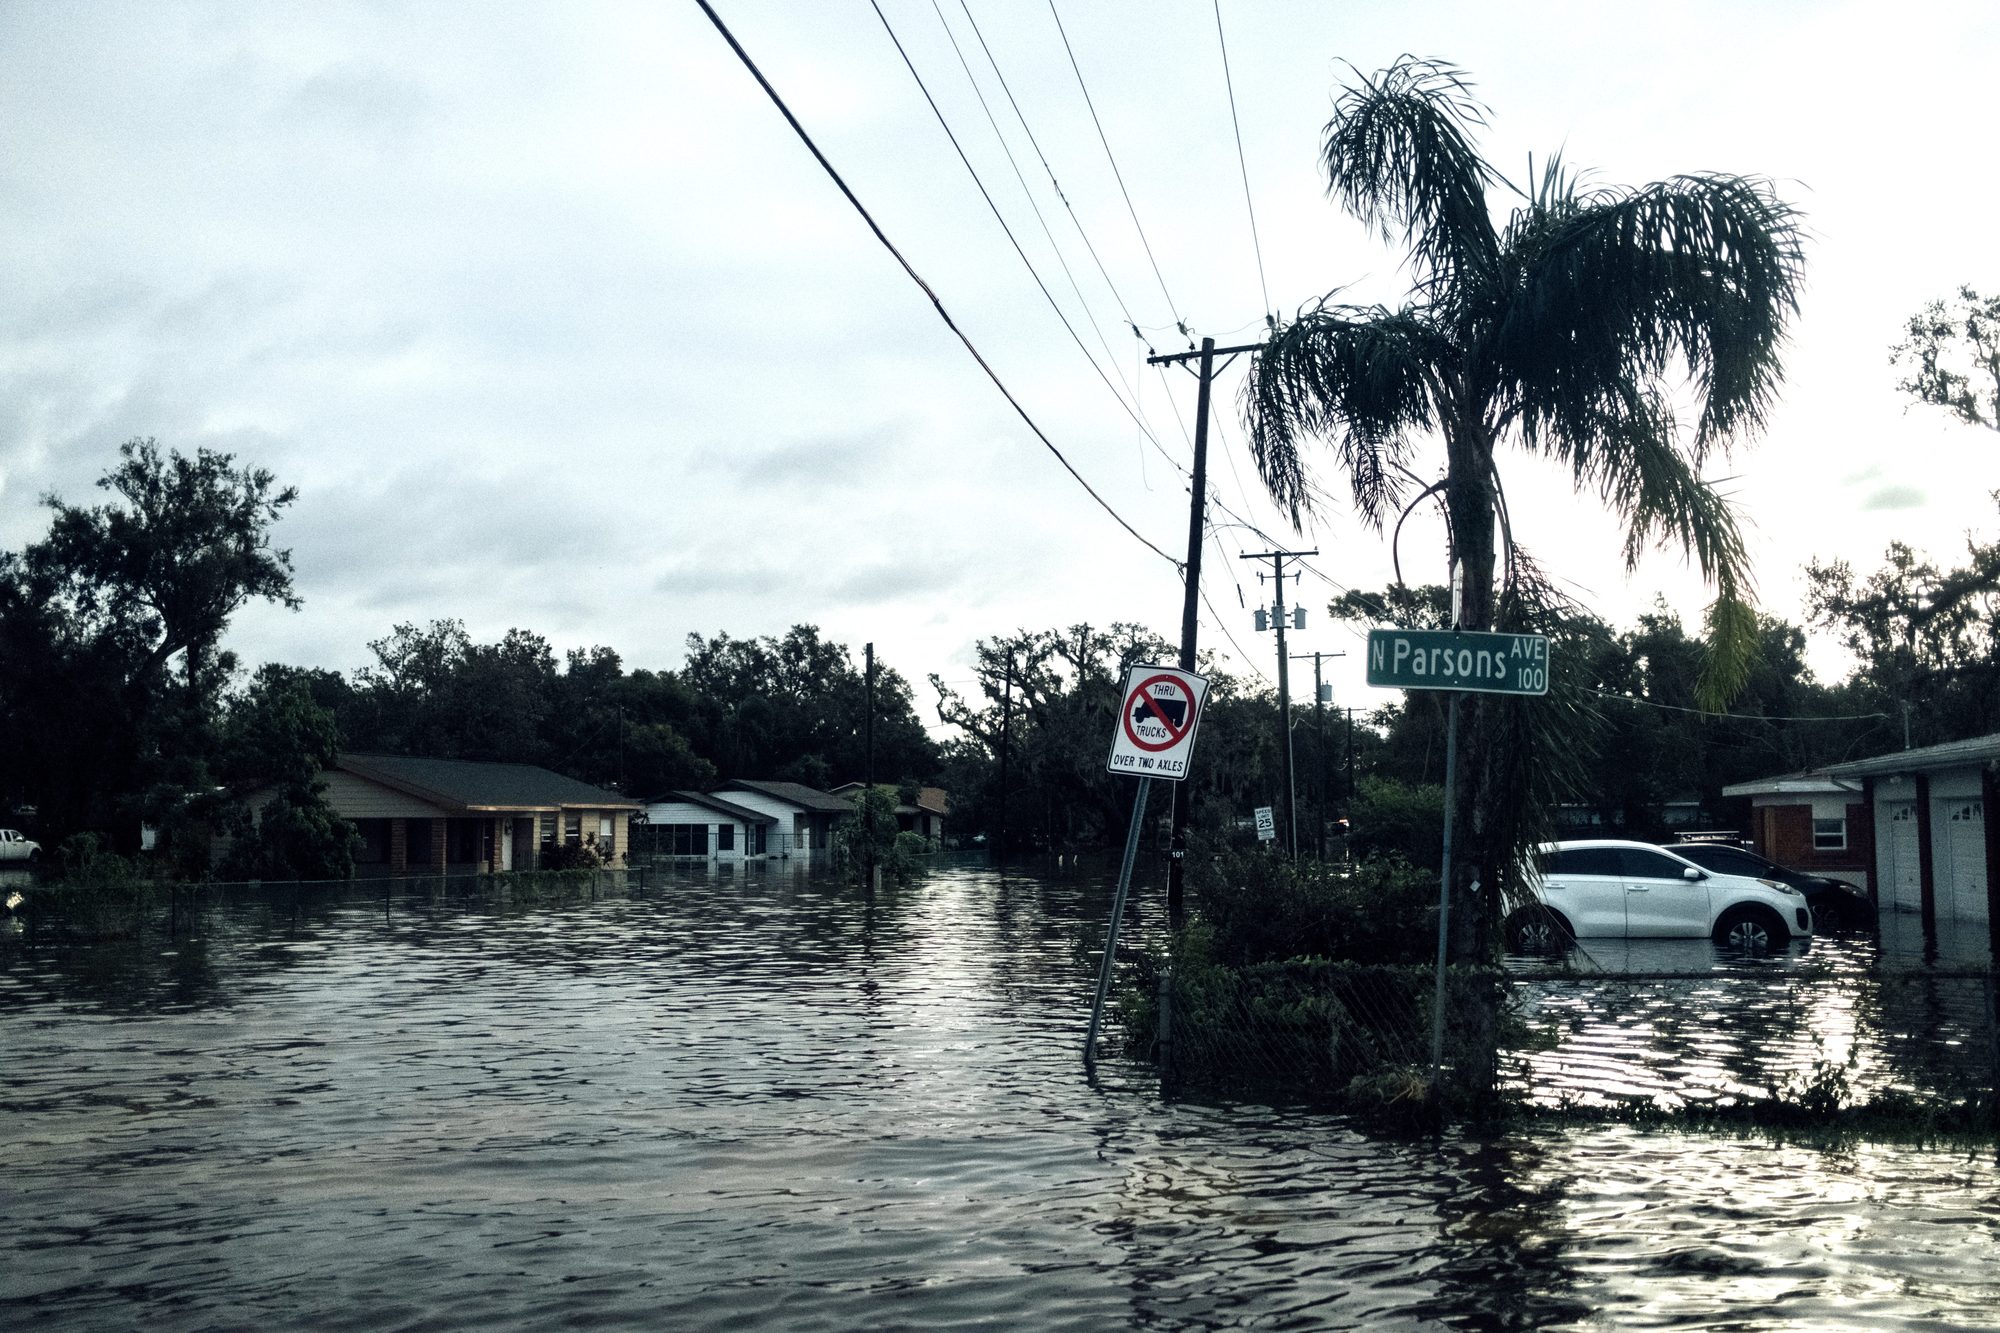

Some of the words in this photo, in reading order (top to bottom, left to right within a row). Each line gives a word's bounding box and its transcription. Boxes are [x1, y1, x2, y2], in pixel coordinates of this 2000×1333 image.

[1372, 639, 1384, 671] N
[1393, 638, 1506, 679] Parsons
[1510, 637, 1544, 660] AVE
[1517, 667, 1543, 690] 100
[1153, 684, 1176, 696] THRU
[1136, 725, 1167, 738] TRUCKS
[1113, 754, 1135, 767] OVER
[1138, 757, 1154, 769] TWO
[1156, 759, 1184, 772] AXLES
[1258, 818, 1272, 828] 25
